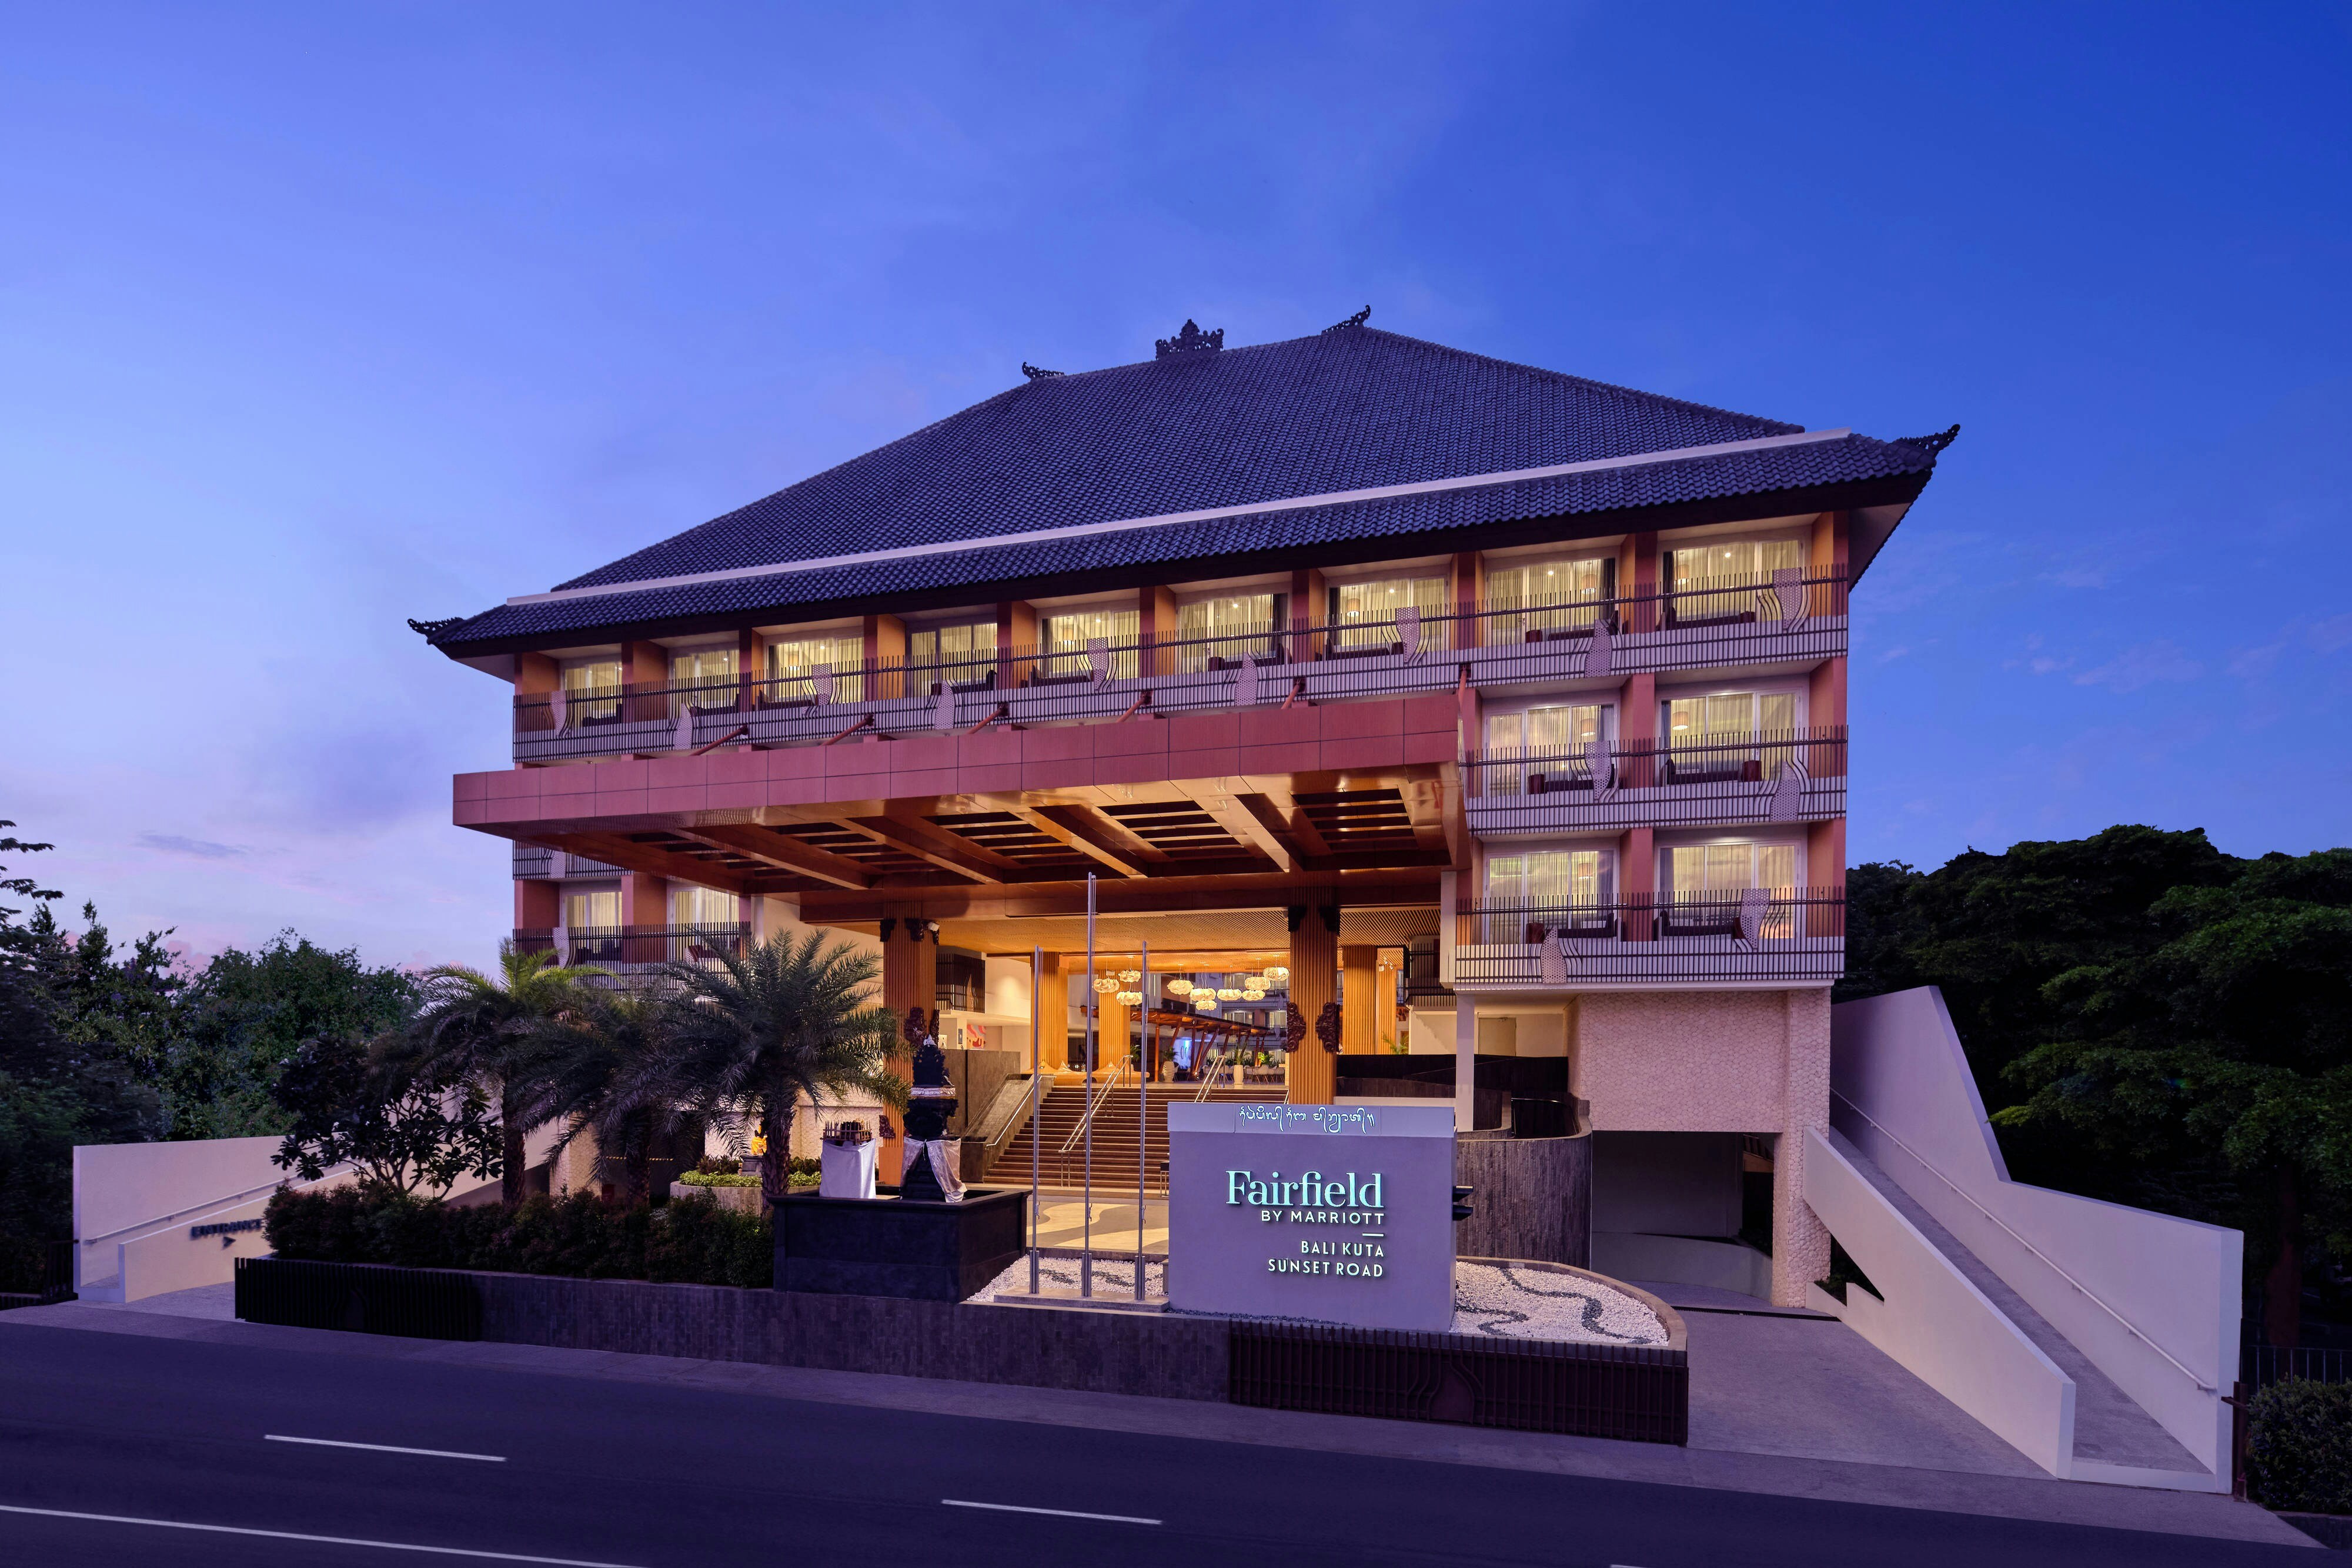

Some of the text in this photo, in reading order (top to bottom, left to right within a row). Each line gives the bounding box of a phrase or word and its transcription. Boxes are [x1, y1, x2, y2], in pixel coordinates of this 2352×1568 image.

[1225, 1171, 1384, 1208] Fairfield
[1261, 1210, 1384, 1225] BY MARRIOTT
[1301, 1241, 1384, 1257] BALI KUTA
[1268, 1259, 1383, 1277] SUNSET ROAD
